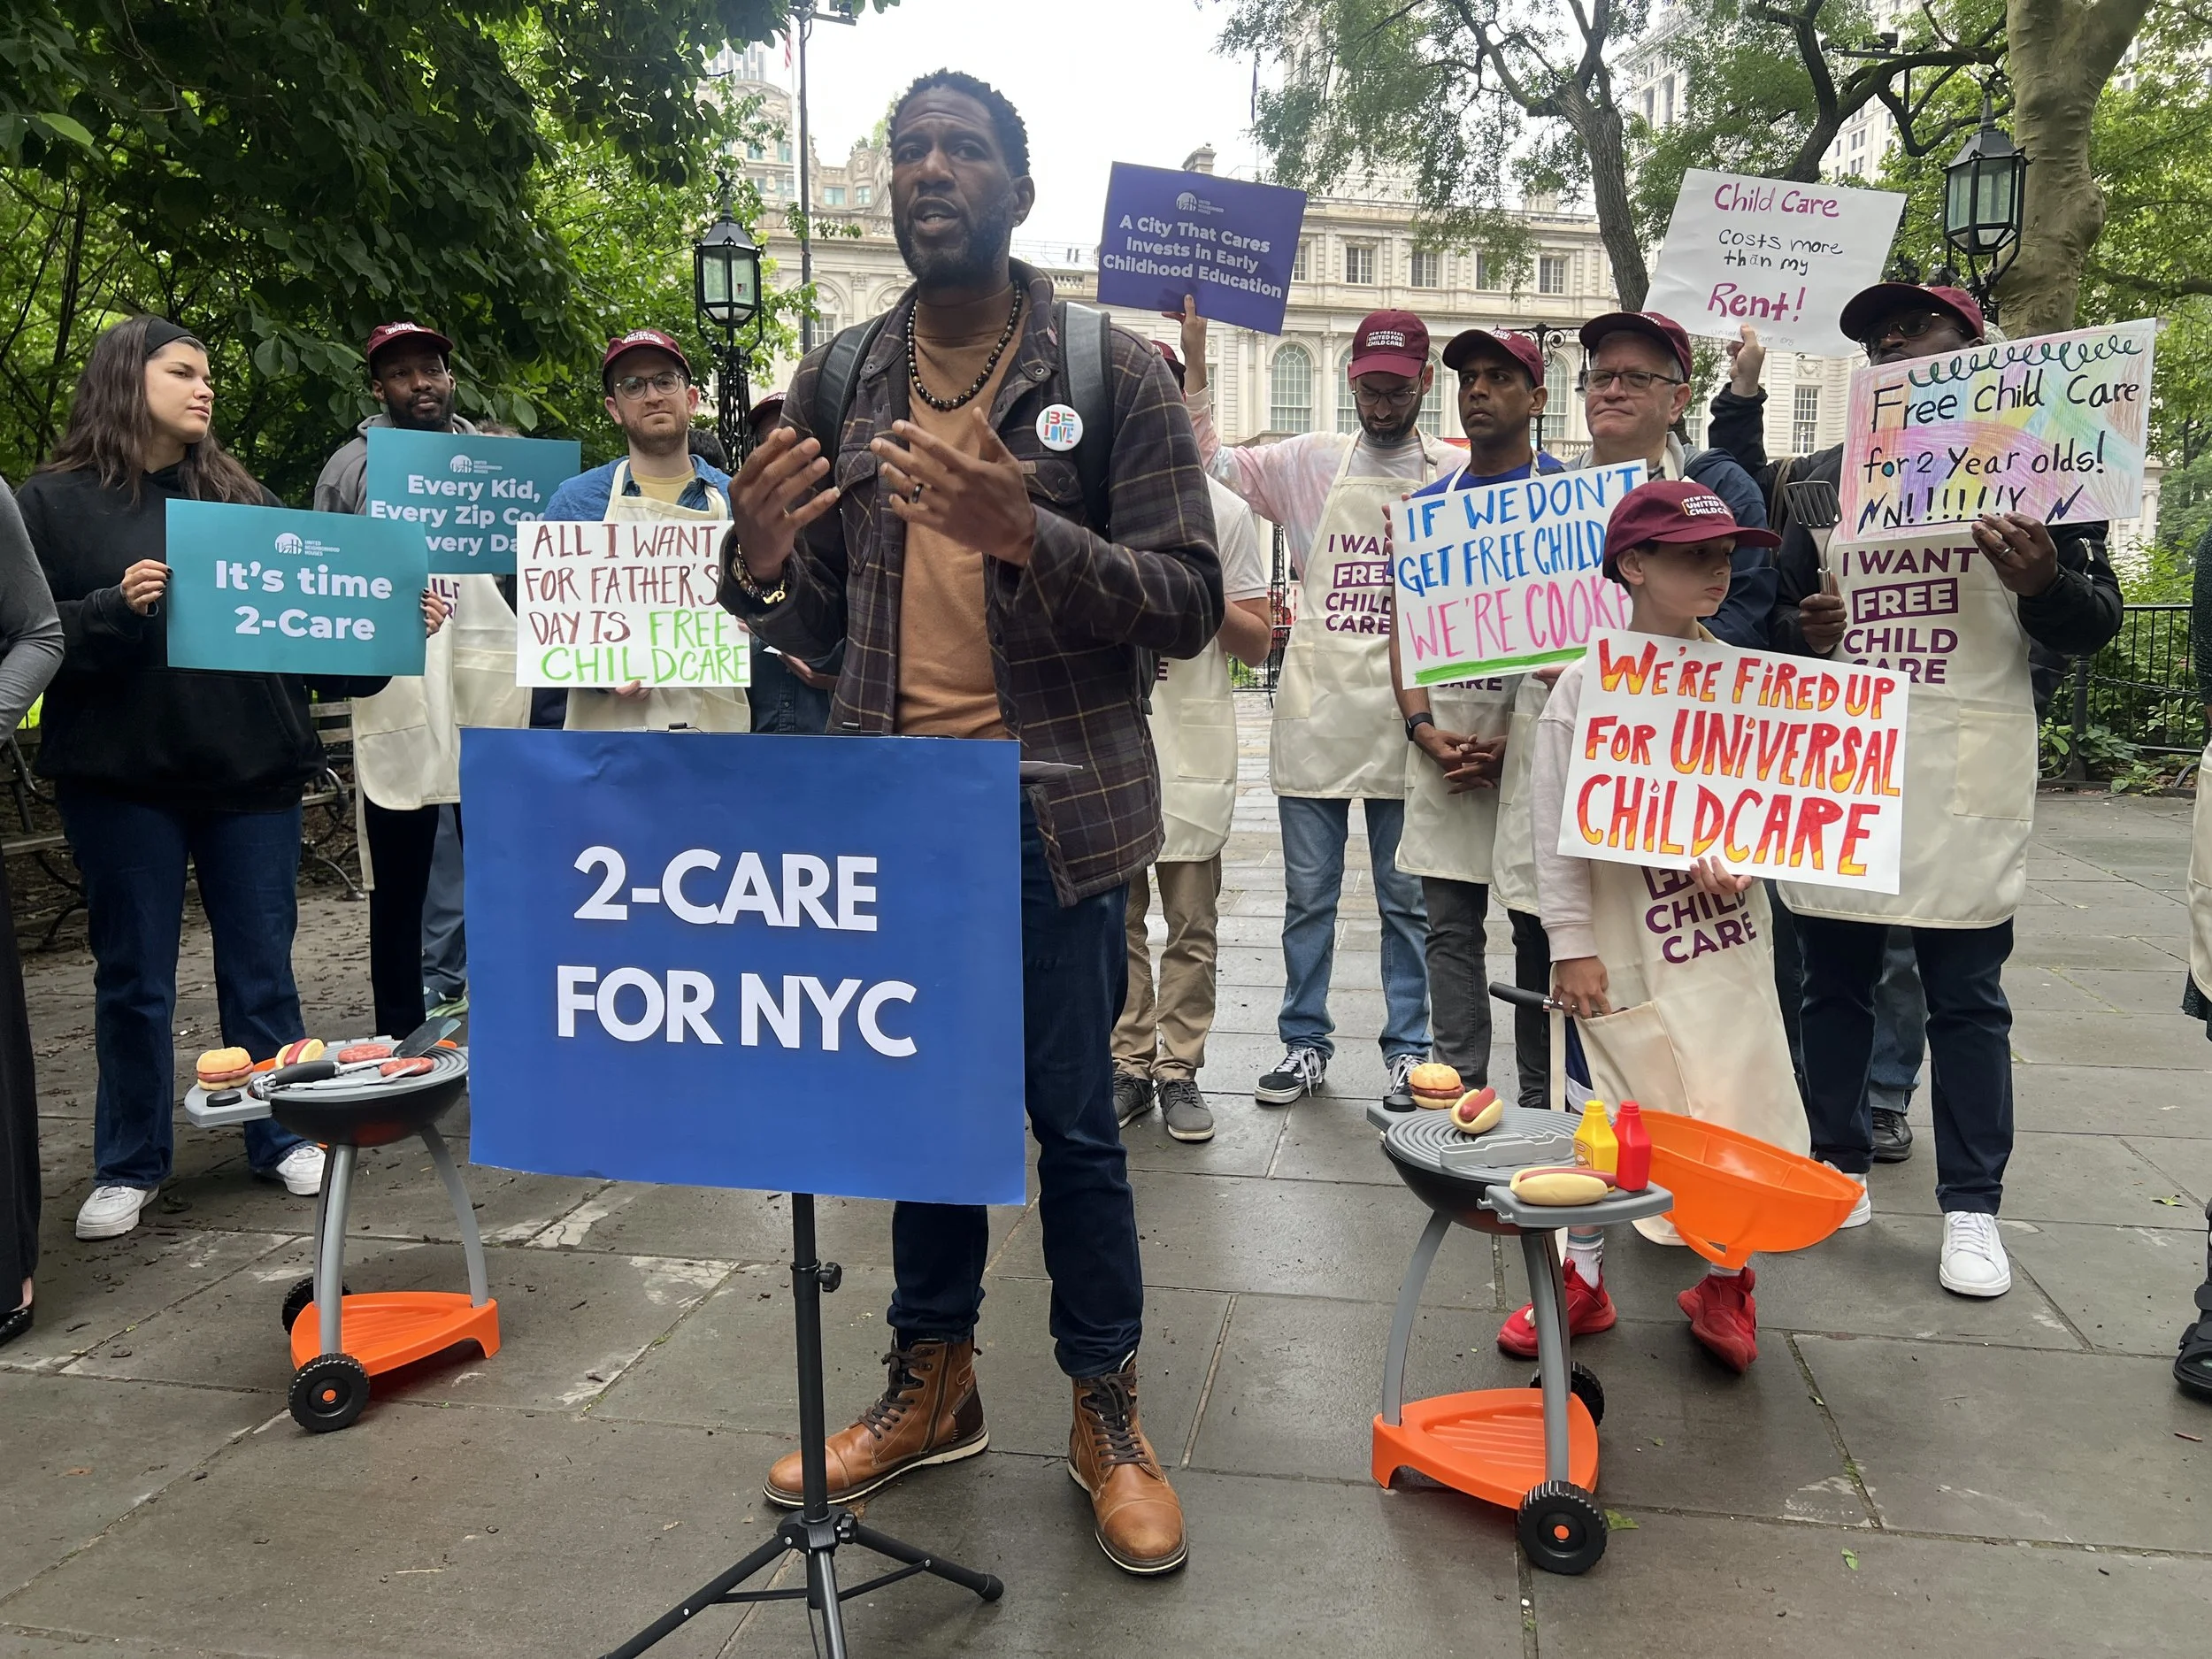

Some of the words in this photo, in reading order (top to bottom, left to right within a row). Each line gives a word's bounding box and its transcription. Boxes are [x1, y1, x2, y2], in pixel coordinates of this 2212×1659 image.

[1714, 182, 1776, 213] Child
[1781, 189, 1839, 218] Care
[1118, 215, 1133, 230] A
[1137, 217, 1172, 238] City
[1178, 221, 1217, 242] That
[1221, 230, 1271, 254] Cares
[1790, 238, 1843, 255] more
[1126, 236, 1190, 257] Invests
[1194, 243, 1211, 261] in
[1216, 249, 1259, 275] Early
[1724, 249, 1772, 268] than
[1779, 257, 1809, 276] my
[1102, 254, 1194, 278] Childhood
[1198, 265, 1282, 299] Education
[1707, 282, 1807, 323] Rent!
[1045, 411, 1075, 426] BE
[1871, 383, 1959, 434] Free
[2067, 374, 2139, 407] Care
[1044, 424, 1073, 443] LOVE
[1863, 447, 1909, 483] for
[1916, 451, 1934, 473] 2
[2032, 430, 2105, 473] olds!
[408, 474, 484, 502] Every
[491, 478, 541, 503] Kid,
[1407, 499, 1446, 542] IF
[1463, 487, 1519, 530] WE
[1525, 465, 1641, 524] DON'T
[1686, 500, 1719, 509] UNITED
[371, 501, 448, 528] Every
[455, 504, 495, 529] Zip
[1689, 507, 1717, 516] CHILD
[426, 534, 484, 557] very
[532, 524, 592, 560] ALL
[602, 523, 619, 559] I
[633, 525, 718, 559] WANT
[1328, 534, 1335, 553] I
[1398, 544, 1455, 597] GET
[1463, 529, 1530, 587] FREE
[1533, 520, 1606, 575] CHILD
[216, 560, 285, 593] It's
[296, 564, 393, 600] time
[1842, 551, 1849, 577] I
[1858, 548, 1979, 574] WANT
[524, 566, 581, 605] FOR
[590, 563, 719, 608] FATHER'S
[1856, 583, 1953, 619] FREE
[234, 605, 376, 641] 2-Care
[528, 611, 580, 646] DAY
[589, 611, 631, 645] IS
[648, 609, 730, 649] FREE
[1325, 613, 1391, 635] CARE
[1406, 587, 1517, 661] WE'RE
[1843, 627, 1958, 655] CHILD
[1844, 673, 1895, 719] UP
[1585, 715, 1656, 765] FOR
[573, 845, 878, 932] 2-CARE
[1663, 911, 1757, 964] CARE
[557, 964, 724, 1046] FOR
[741, 972, 918, 1058] NYC
